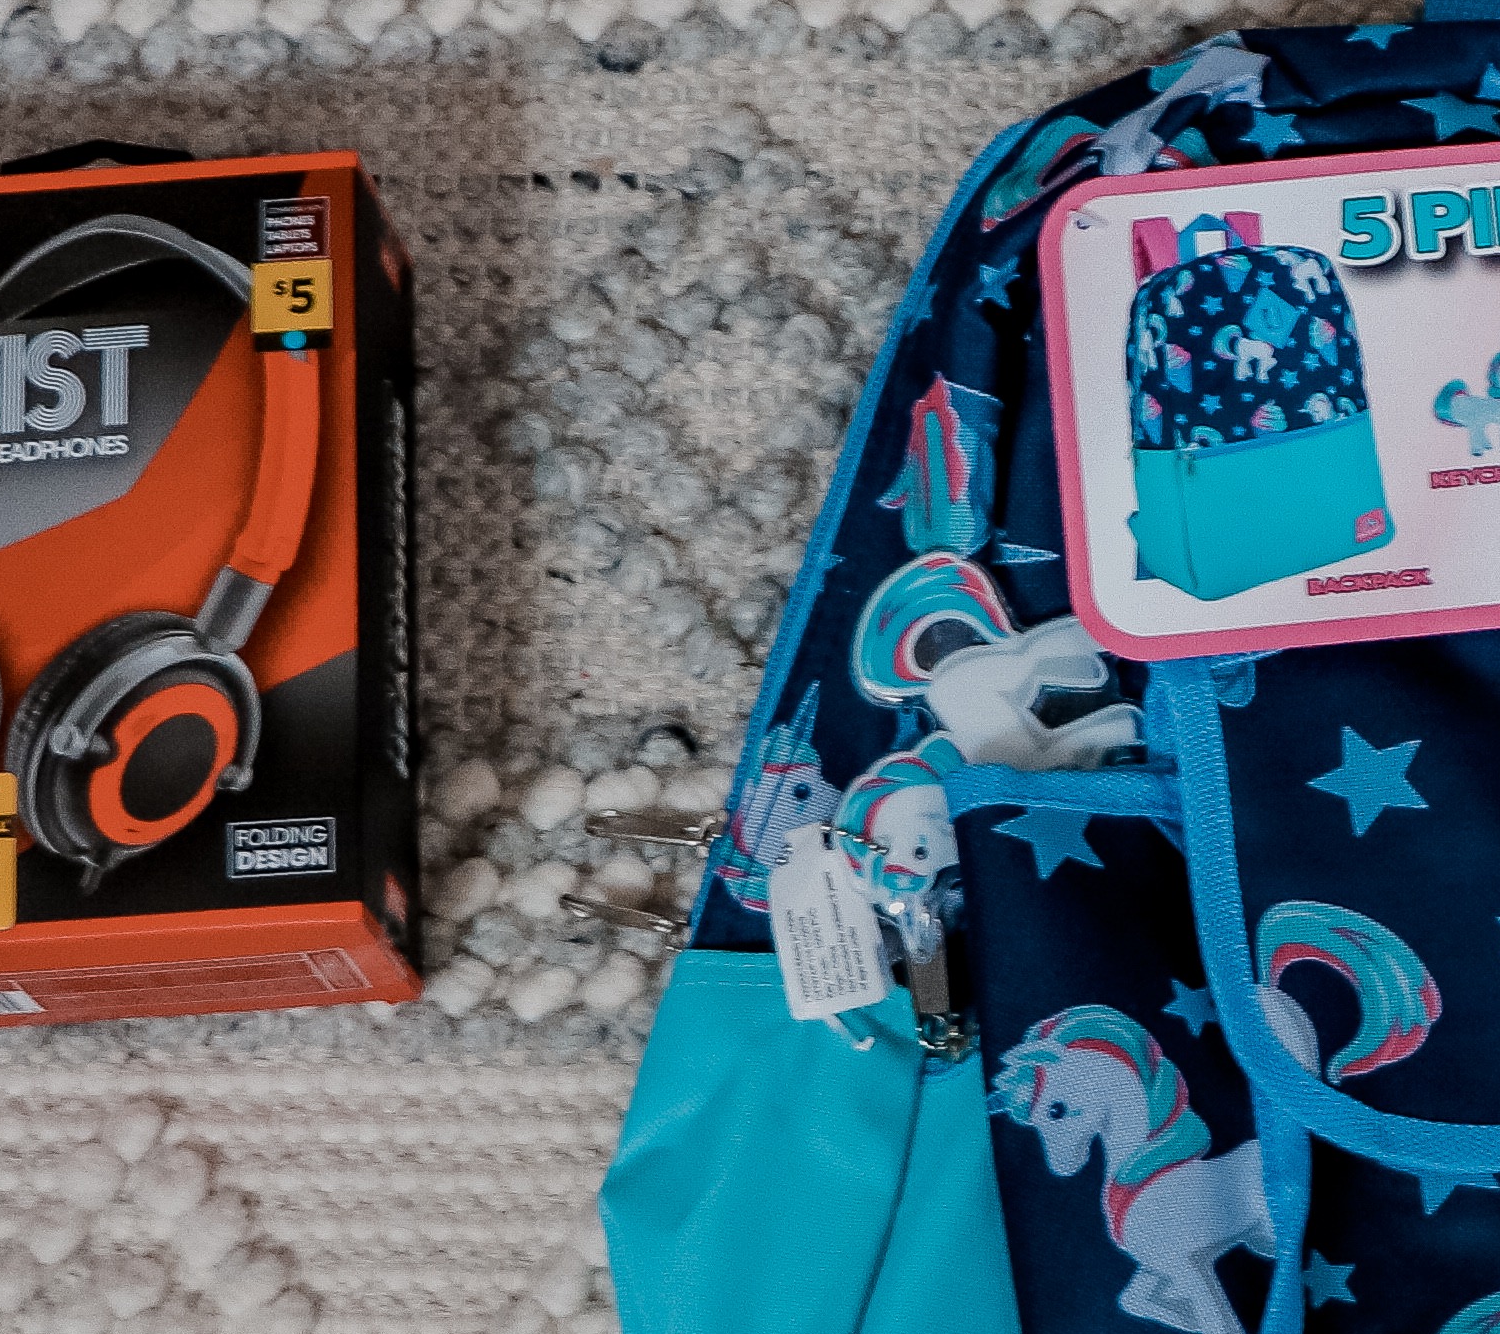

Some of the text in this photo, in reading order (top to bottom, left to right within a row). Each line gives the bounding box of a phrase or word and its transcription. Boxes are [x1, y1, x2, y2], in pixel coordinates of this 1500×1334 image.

[1341, 196, 1395, 262] 5
[273, 278, 315, 314] $5
[1307, 568, 1432, 596] BACKPACK
[235, 825, 328, 847] FOLDING
[235, 847, 328, 870] DESIGN
